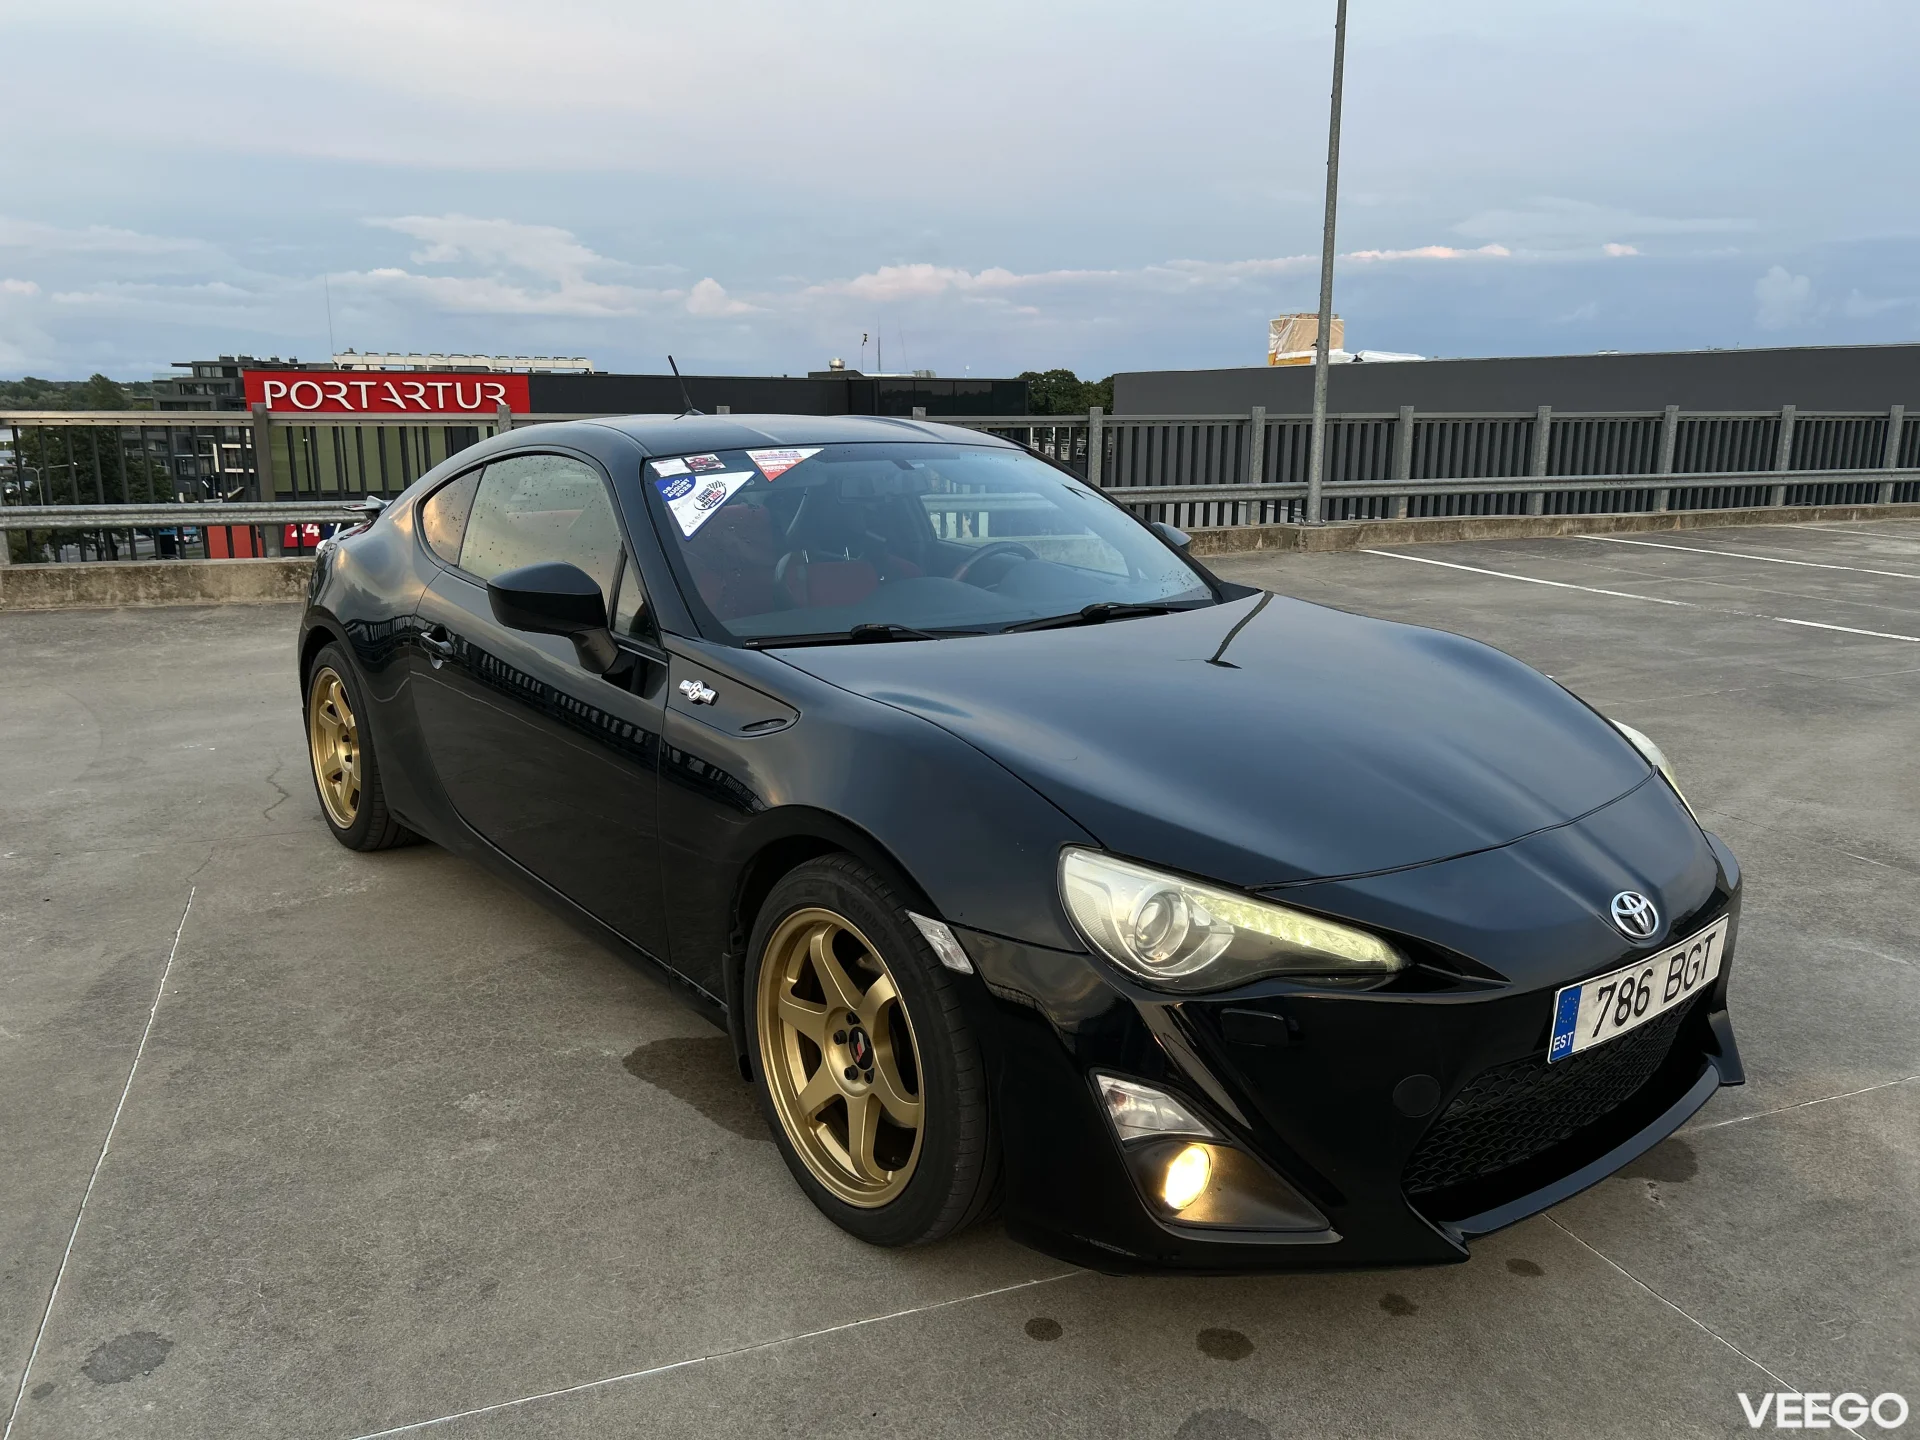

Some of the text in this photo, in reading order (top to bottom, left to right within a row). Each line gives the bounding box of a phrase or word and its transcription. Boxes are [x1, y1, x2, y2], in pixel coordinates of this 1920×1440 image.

[676, 483, 692, 498] 2025
[1592, 932, 1717, 1038] 786 BGT
[1552, 1031, 1574, 1052] EST
